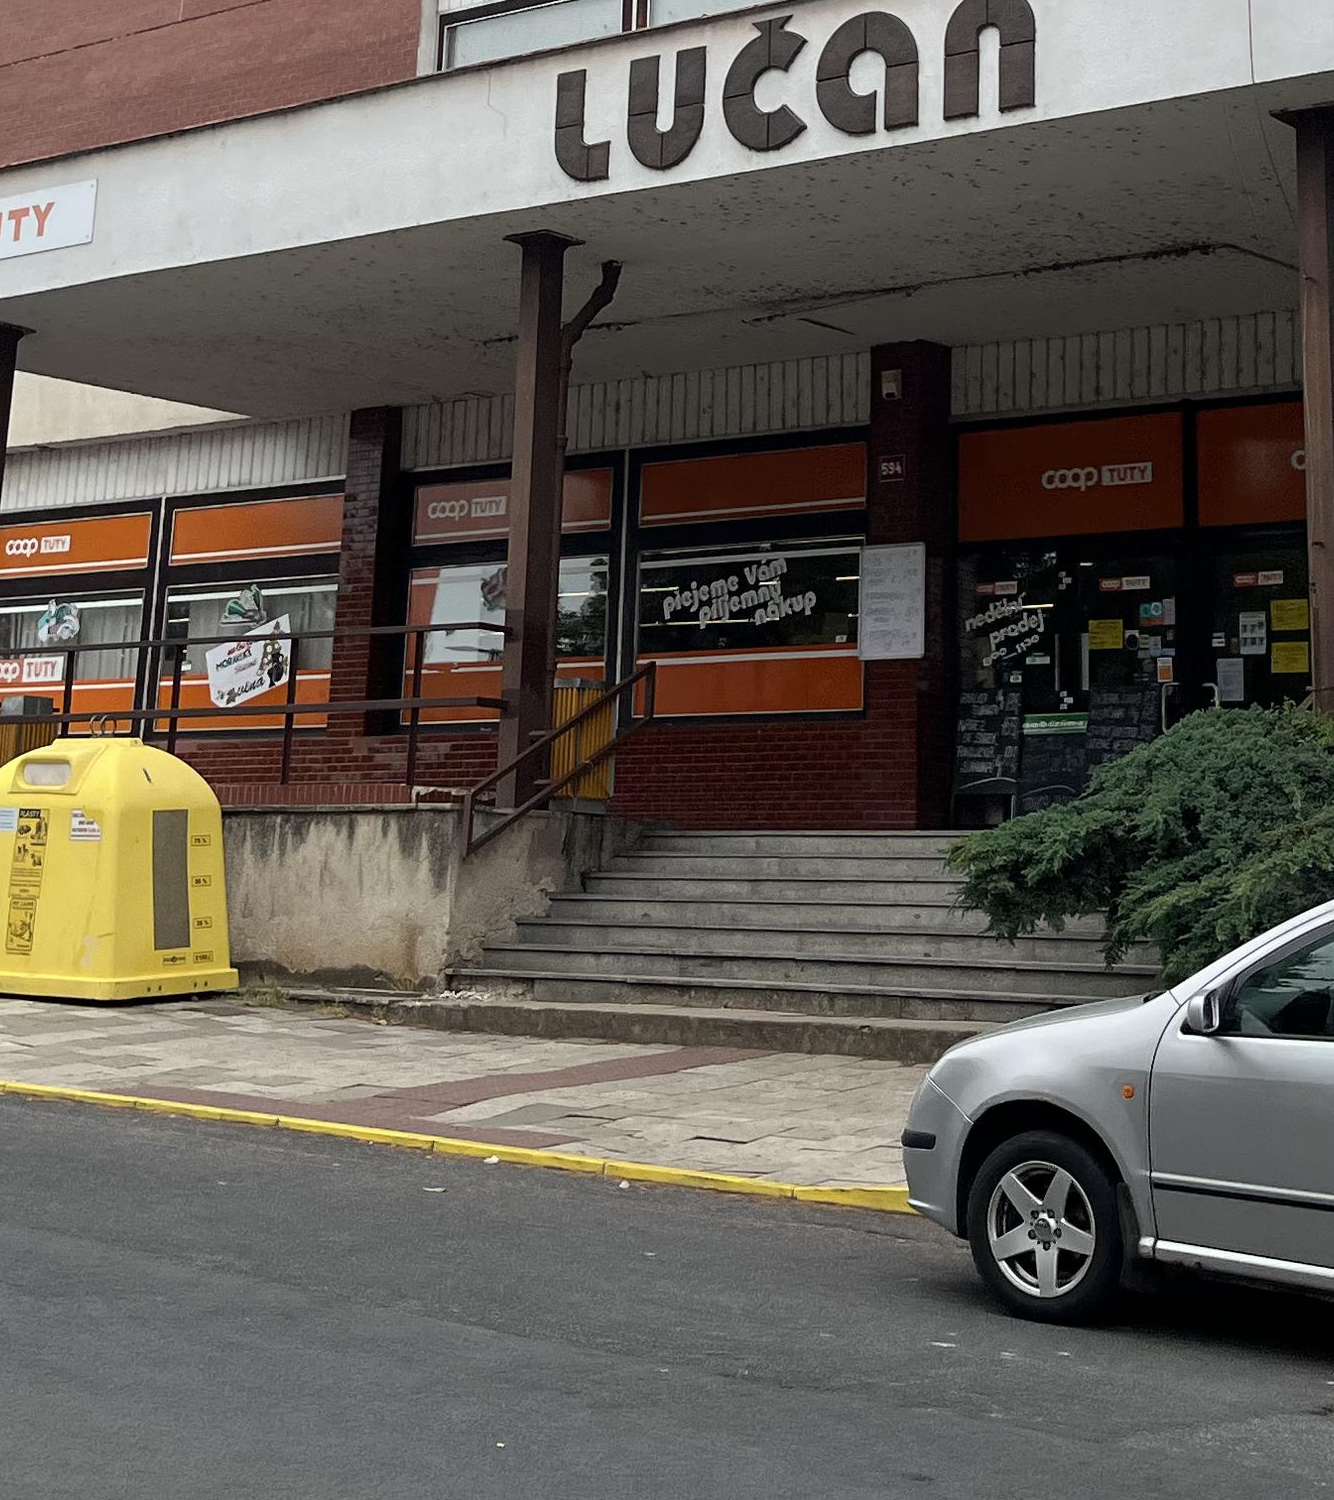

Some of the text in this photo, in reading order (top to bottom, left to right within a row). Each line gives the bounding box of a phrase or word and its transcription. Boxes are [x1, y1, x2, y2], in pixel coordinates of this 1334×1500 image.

[881, 462, 902, 476] 594
[1041, 465, 1149, 492] coop TUTY
[428, 500, 503, 521] coop TUTY
[5, 538, 67, 557] coop TUTY
[743, 557, 788, 585] Vám
[989, 608, 1045, 651] prodej
[26, 660, 59, 678] TUTY
